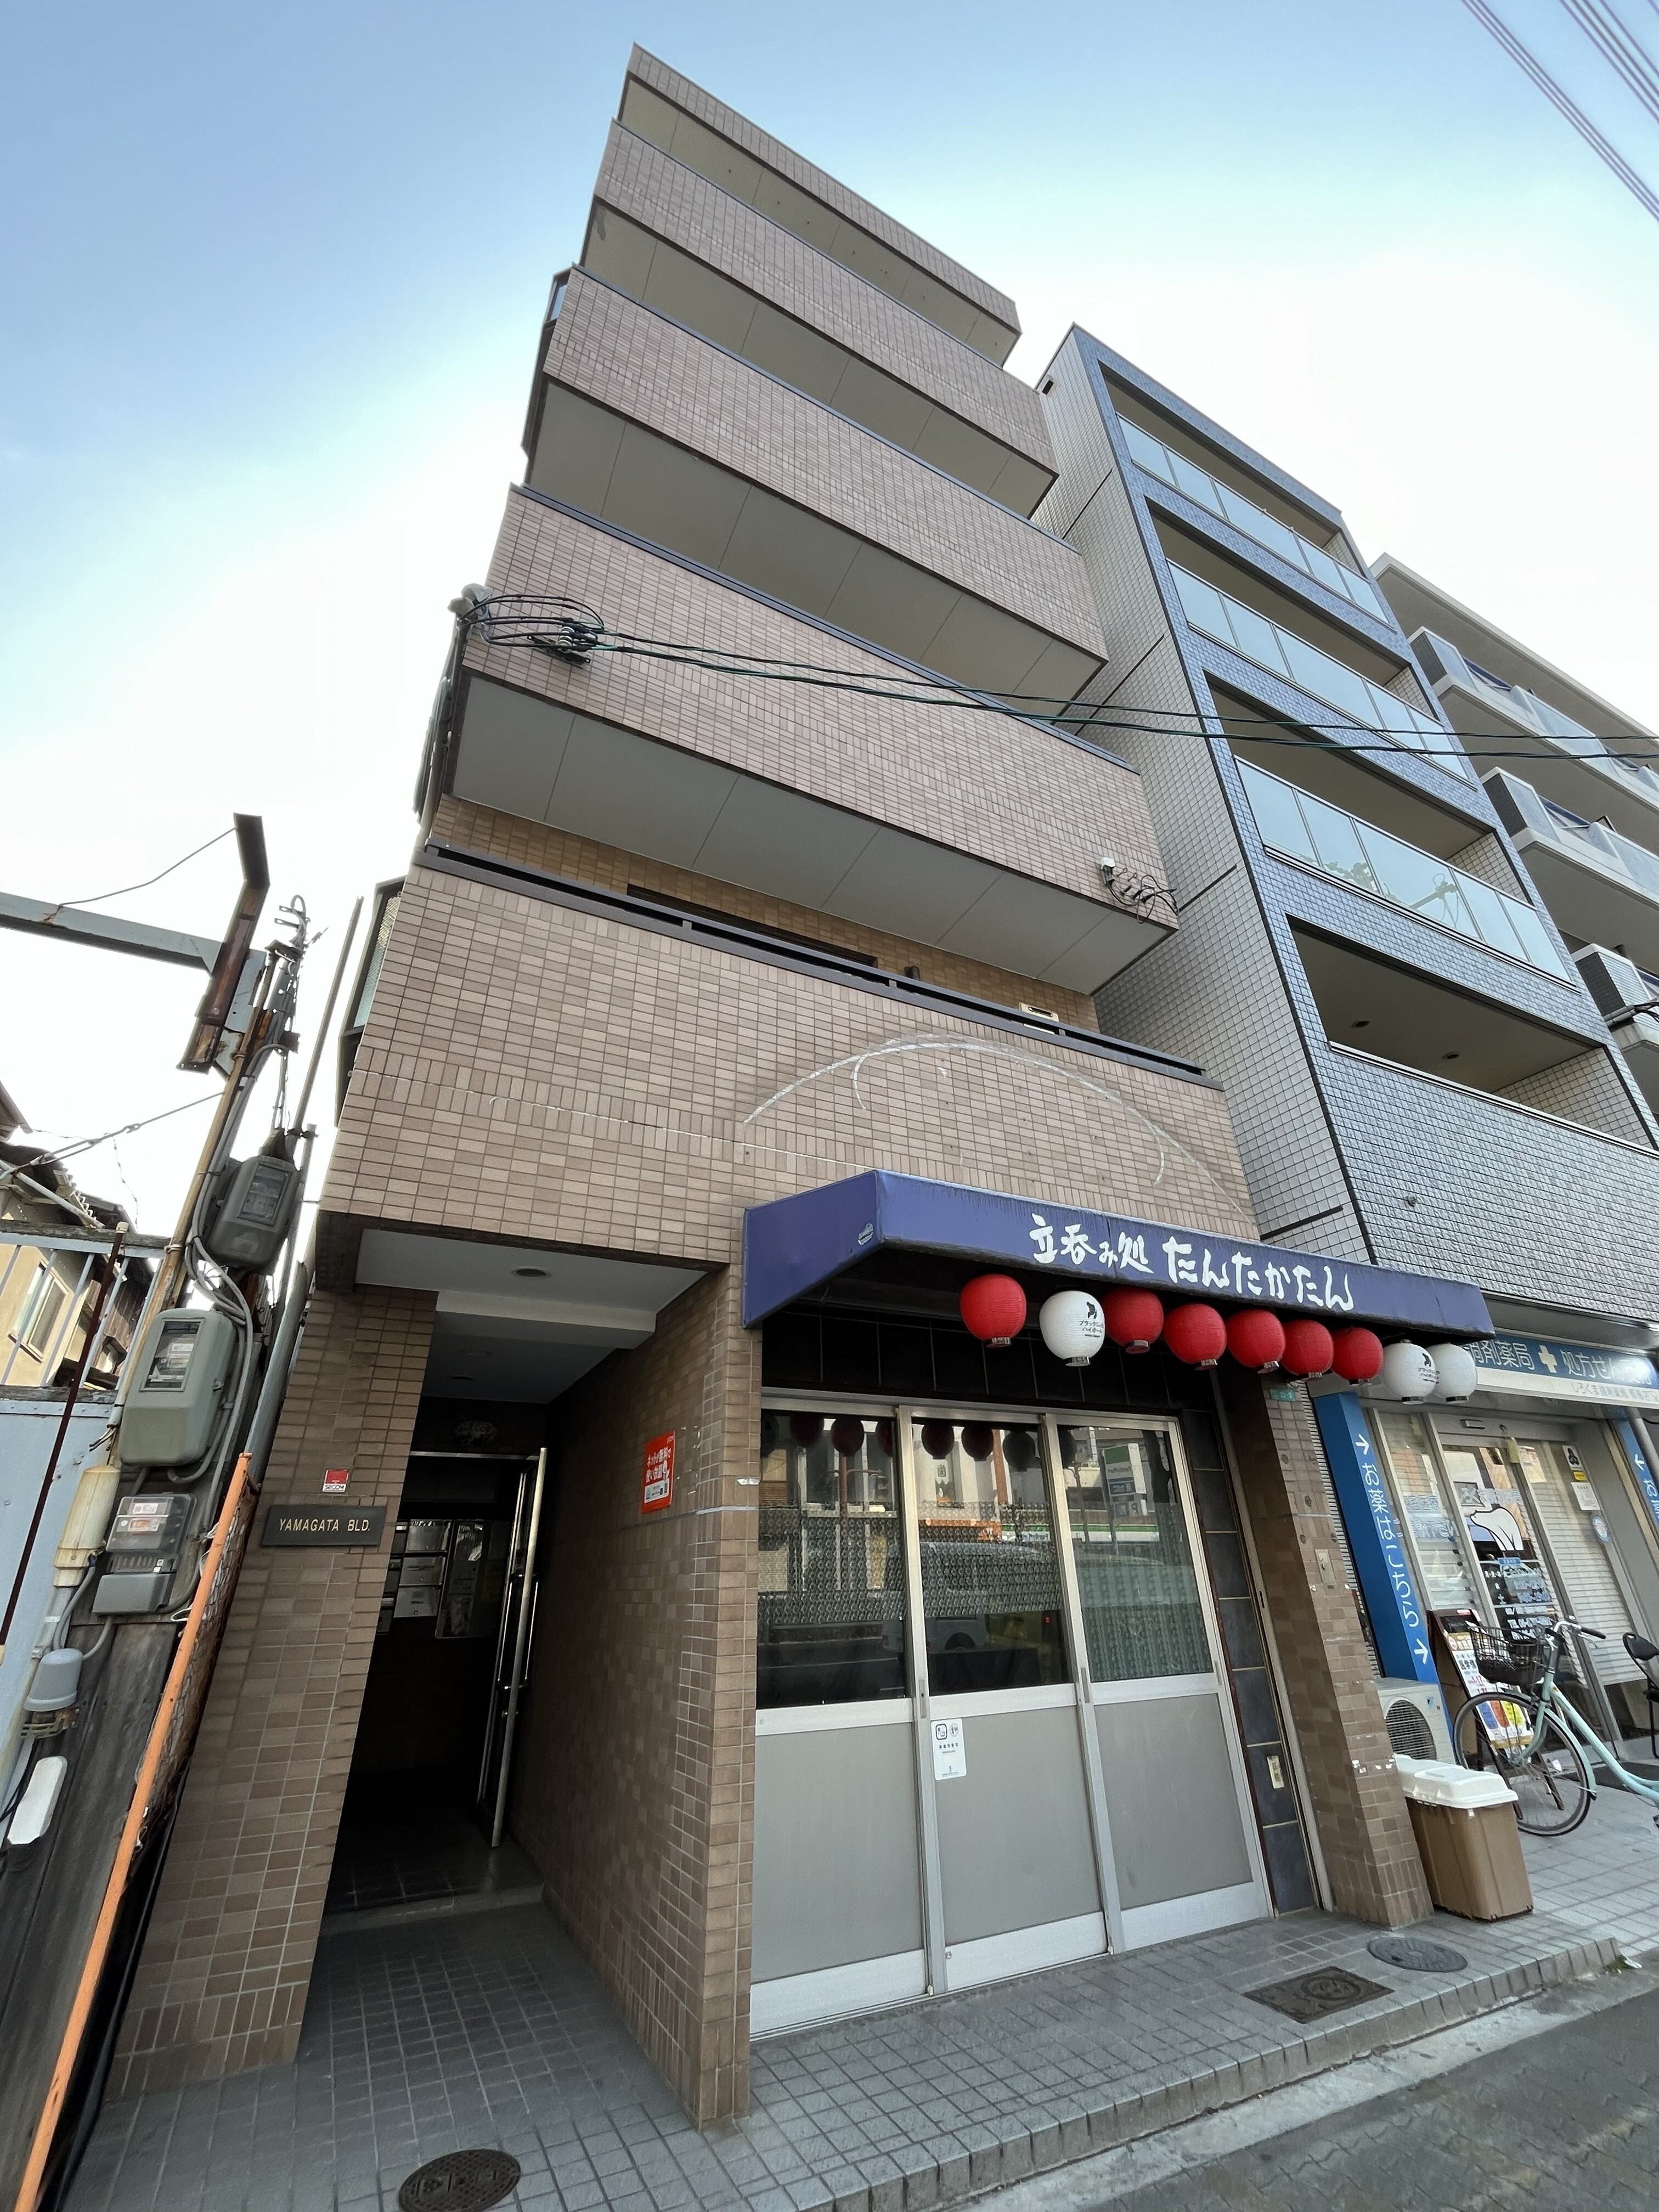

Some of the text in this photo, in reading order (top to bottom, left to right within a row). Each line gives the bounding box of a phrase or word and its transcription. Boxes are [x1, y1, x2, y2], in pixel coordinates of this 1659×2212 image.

[1029, 1213, 1354, 1311] 立呑み処 たんたかたん
[279, 1519, 370, 1532] YAMAGATA BLD.
[1362, 1463, 1419, 1628] お薬はこちら
